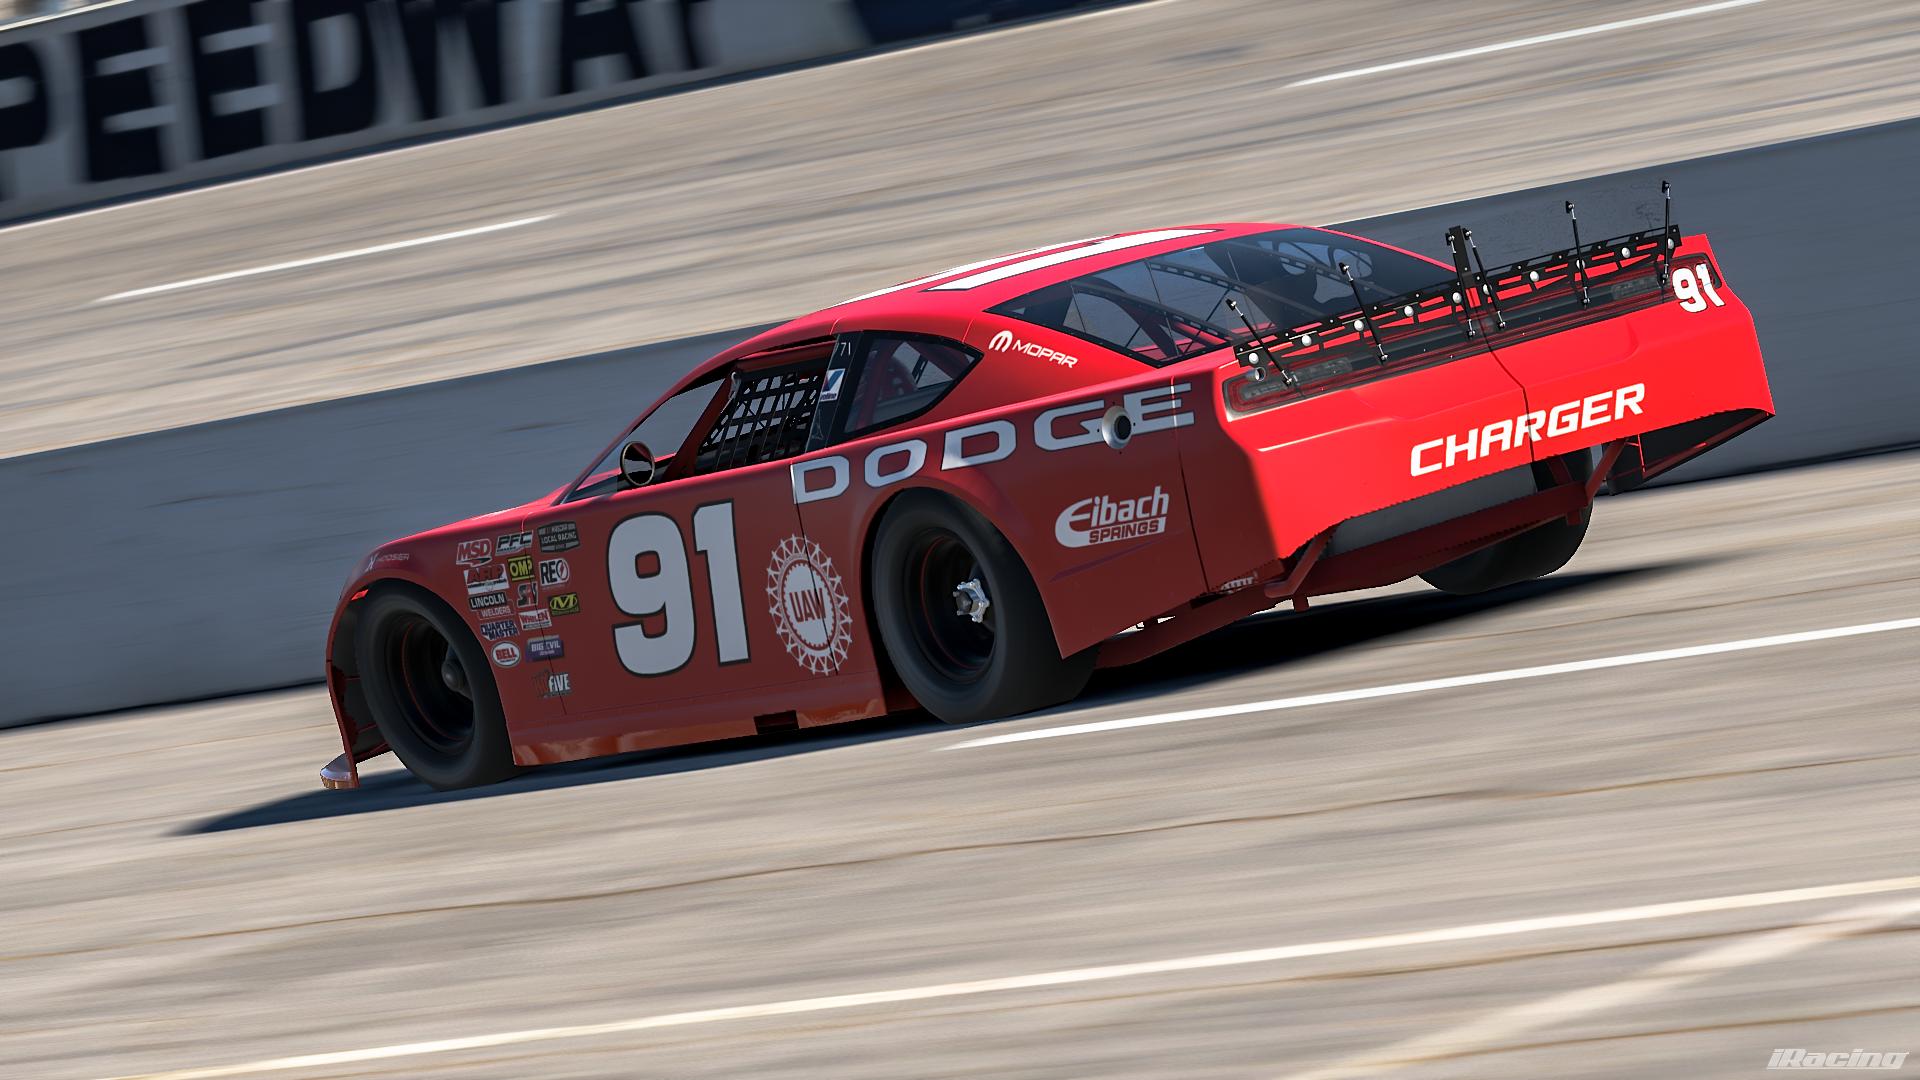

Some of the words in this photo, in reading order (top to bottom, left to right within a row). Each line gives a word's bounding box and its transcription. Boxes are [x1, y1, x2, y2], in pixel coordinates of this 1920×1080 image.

[0, 0, 698, 197] PEEDWA
[1672, 263, 1726, 313] 91
[1011, 340, 1078, 369] MOPAR
[1410, 383, 1645, 477] CHARGER
[790, 383, 1196, 504] DODGE
[1055, 485, 1170, 548] Eibach
[497, 530, 533, 549] PFC
[557, 531, 577, 542] RACING
[1089, 519, 1160, 544] SPRINGS
[459, 540, 491, 561] MSD
[509, 559, 533, 578] OMP
[607, 498, 751, 679] 91
[470, 593, 505, 609] LINCOLN
[480, 605, 512, 617] WELDERS
[789, 587, 827, 624] UAW
[481, 620, 514, 637] QUARTER
[489, 626, 519, 640] MASTER
[495, 647, 517, 661] BELL
[531, 641, 545, 653] BIG
